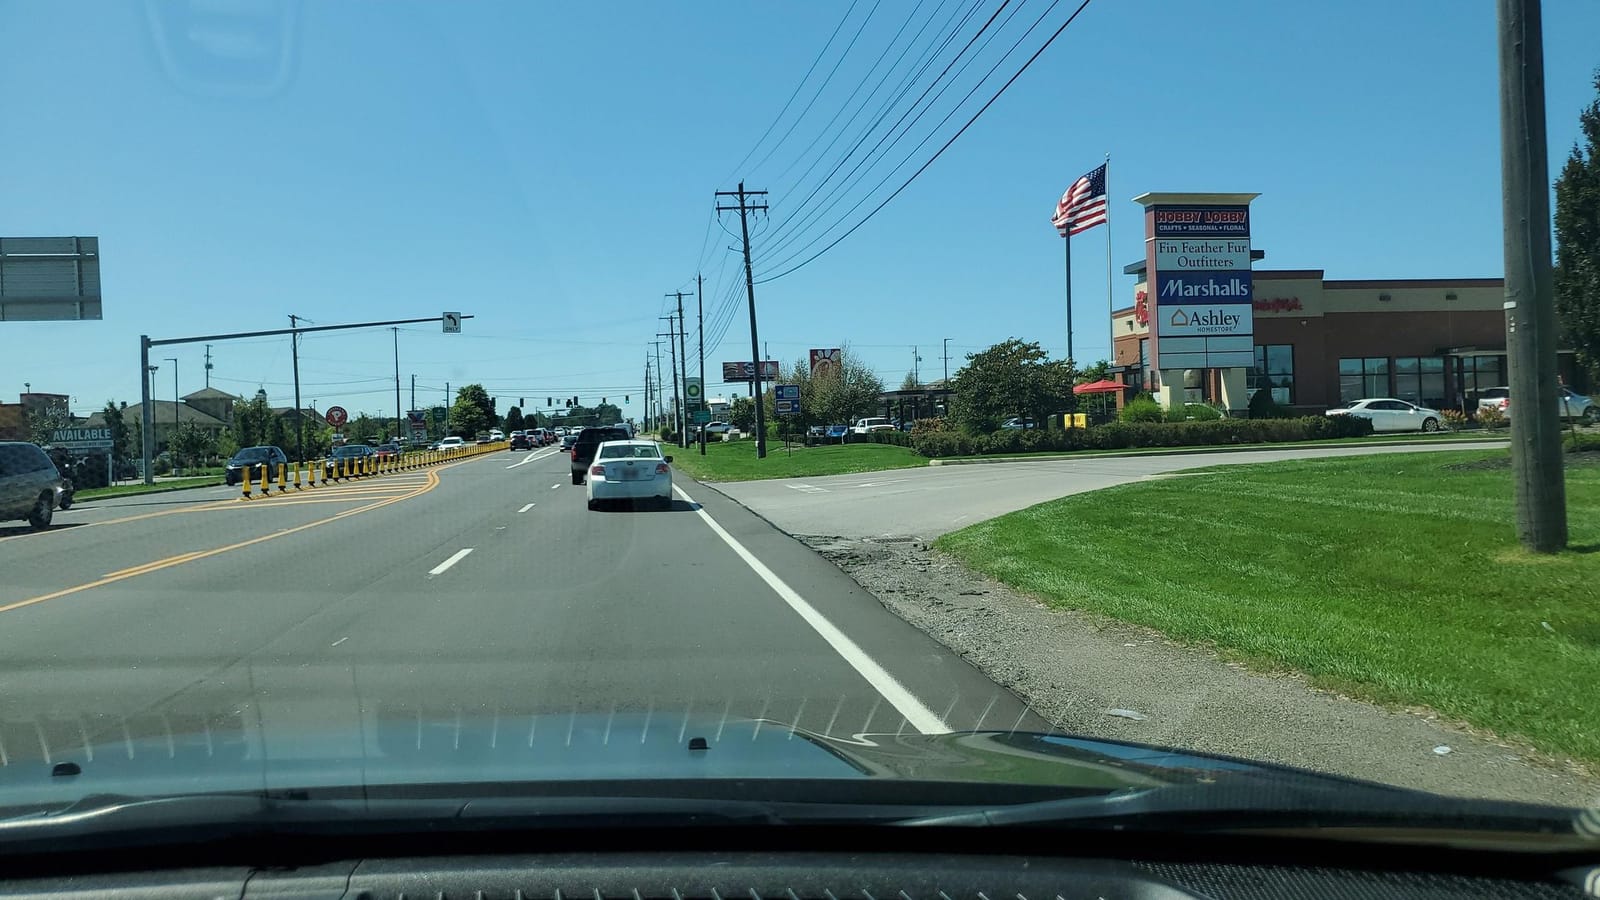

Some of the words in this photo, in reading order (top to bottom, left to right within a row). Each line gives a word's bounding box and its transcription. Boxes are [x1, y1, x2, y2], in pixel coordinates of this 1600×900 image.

[1157, 211, 1201, 223] HOBBY
[1204, 211, 1246, 223] LOBBY
[1159, 242, 1177, 253] Fin
[1182, 242, 1223, 253] Feather
[1227, 242, 1246, 253] Fur
[1177, 256, 1233, 268] Outfitters
[1161, 279, 1248, 297] Marshalls
[1189, 310, 1240, 329] Ashley
[53, 429, 111, 441] AVAILABLE
